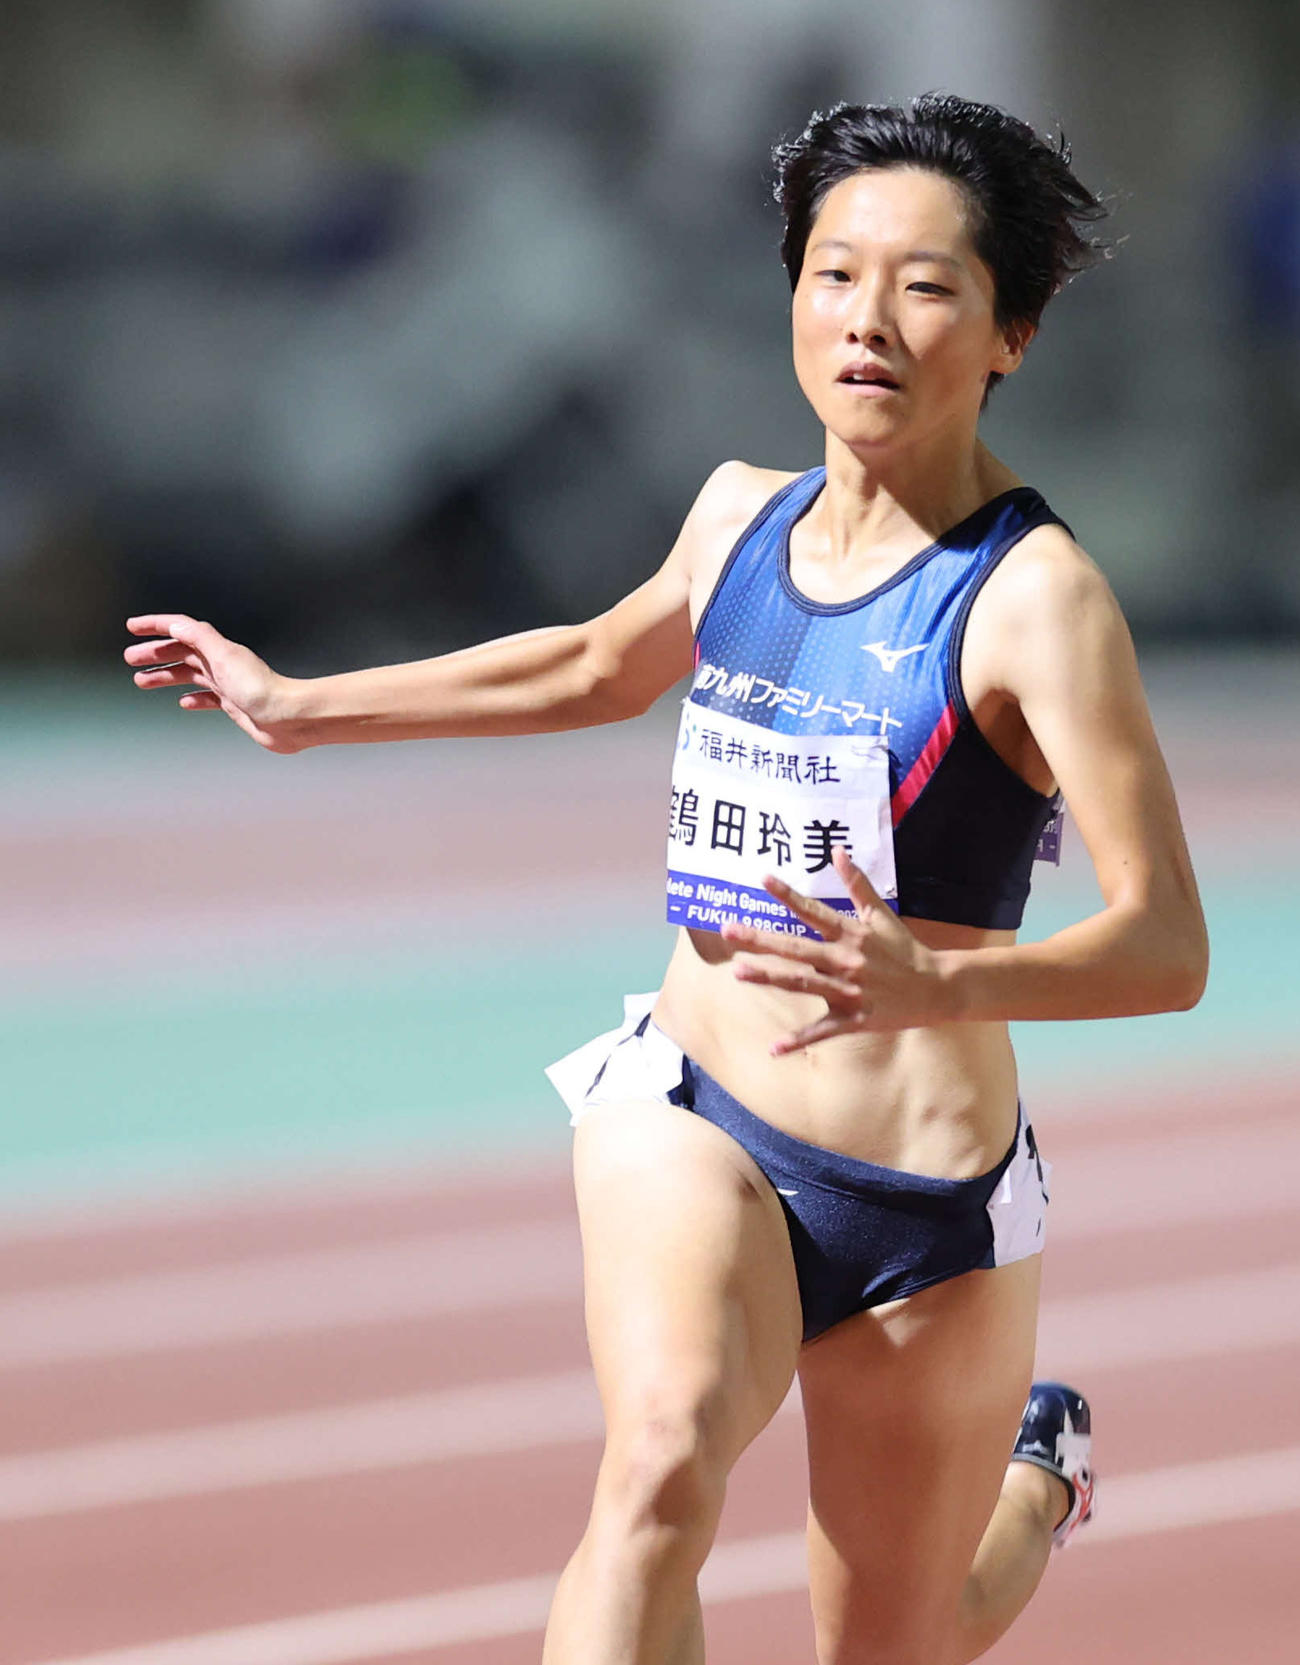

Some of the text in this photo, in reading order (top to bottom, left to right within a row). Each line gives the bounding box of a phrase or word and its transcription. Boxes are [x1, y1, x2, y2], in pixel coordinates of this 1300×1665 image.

[698, 726, 842, 785] 福井新聞社
[696, 882, 738, 907] Night
[739, 892, 788, 919] Games
[687, 903, 739, 925] FUKUI
[741, 914, 807, 937] 998CUP
